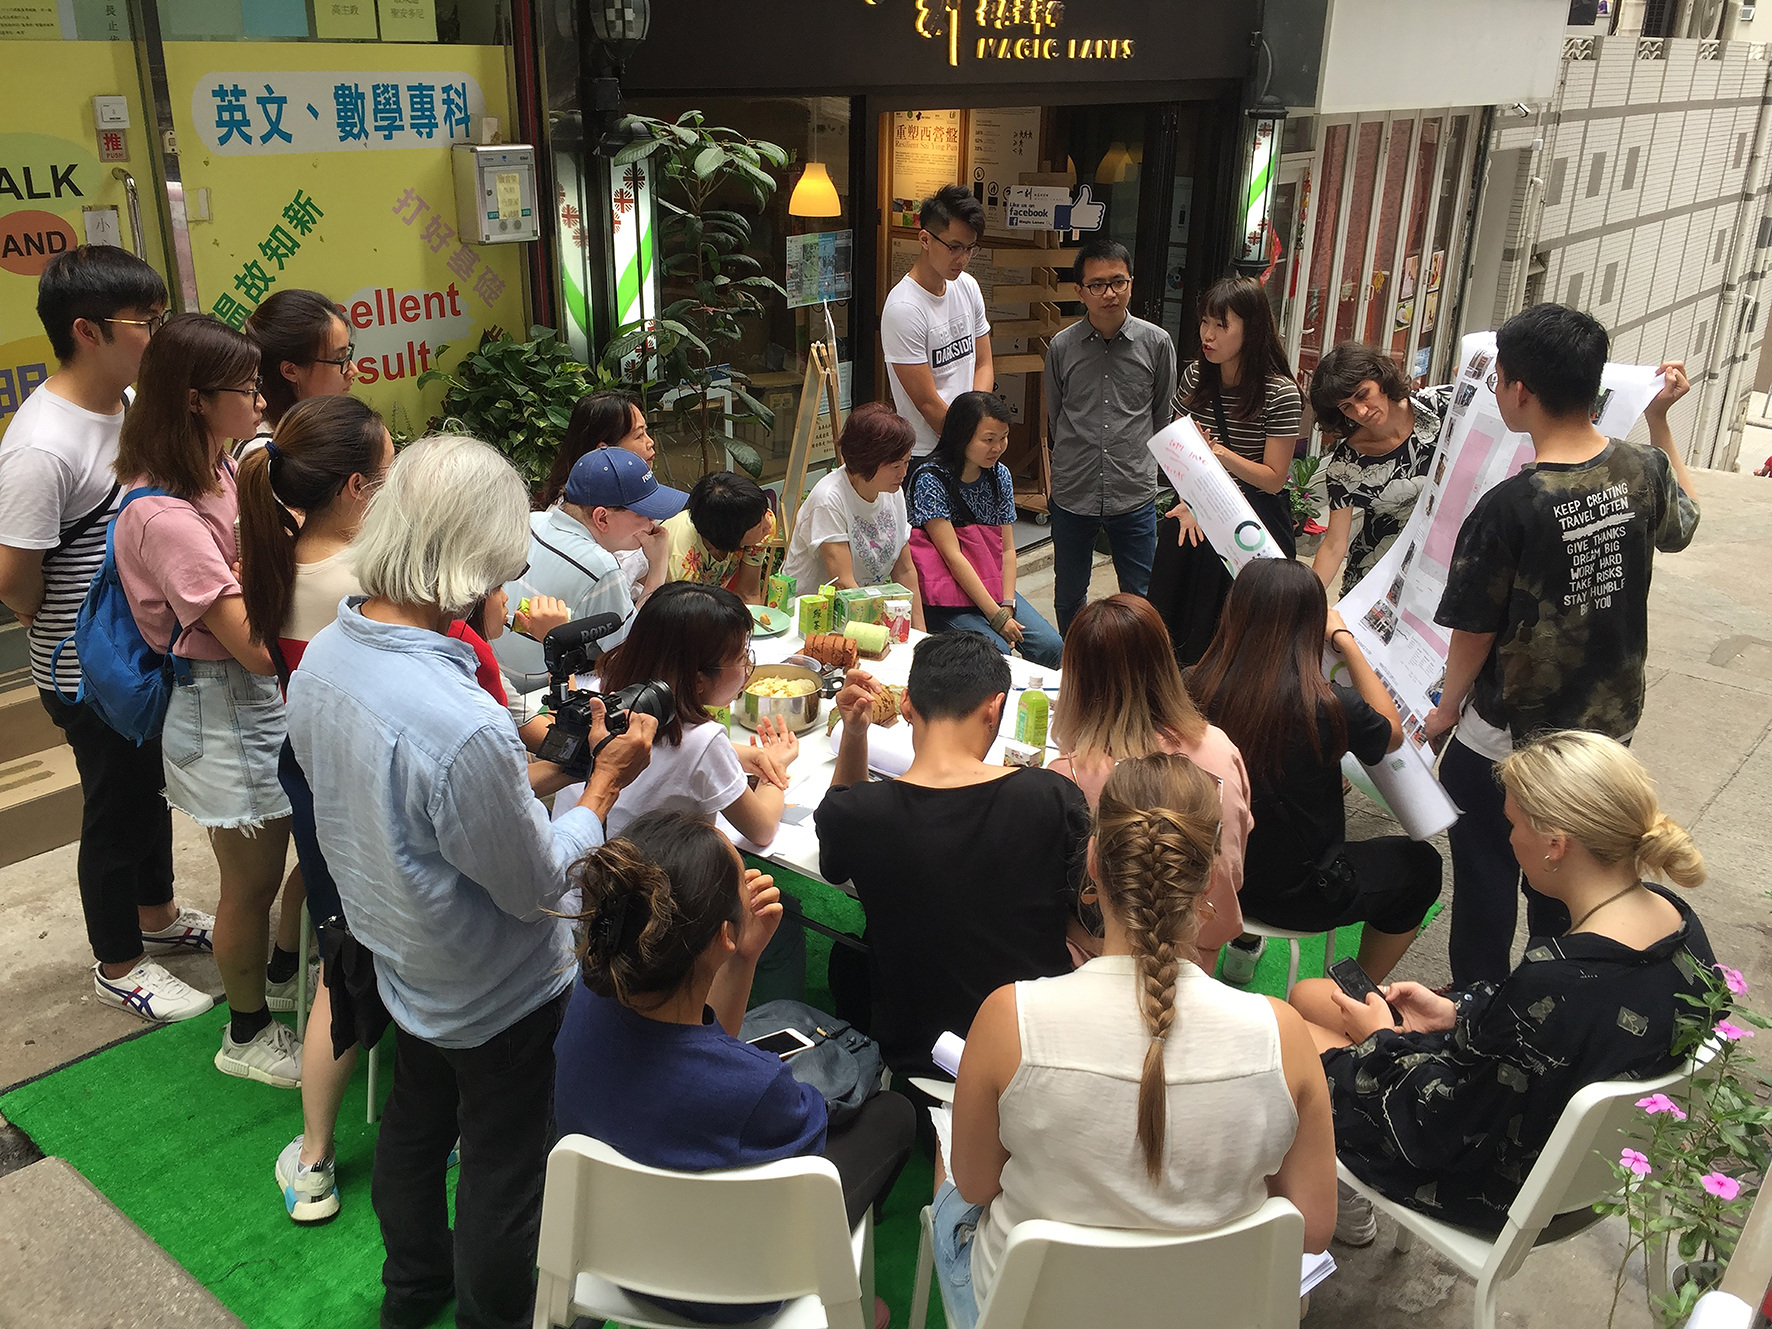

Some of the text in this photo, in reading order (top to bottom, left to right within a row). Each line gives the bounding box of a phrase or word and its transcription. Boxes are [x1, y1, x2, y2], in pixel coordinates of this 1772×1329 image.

[211, 82, 471, 146] 英文、數學專科
[103, 133, 123, 151] 推
[1009, 207, 1049, 217] facebook
[2, 231, 67, 258] AND
[392, 187, 506, 308] 打好基礎
[1553, 482, 1628, 517] KEEP CREATING
[1559, 497, 1629, 530] TRAVEL OFTEN
[1567, 526, 1627, 554] GIVE THANKS
[1573, 541, 1620, 566] DREAM BIG
[1569, 566, 1623, 592] TAKE RISKS
[1570, 553, 1623, 580] WORK HARD
[1563, 578, 1625, 606] STAY HUMBLE
[1594, 595, 1612, 609] YOU
